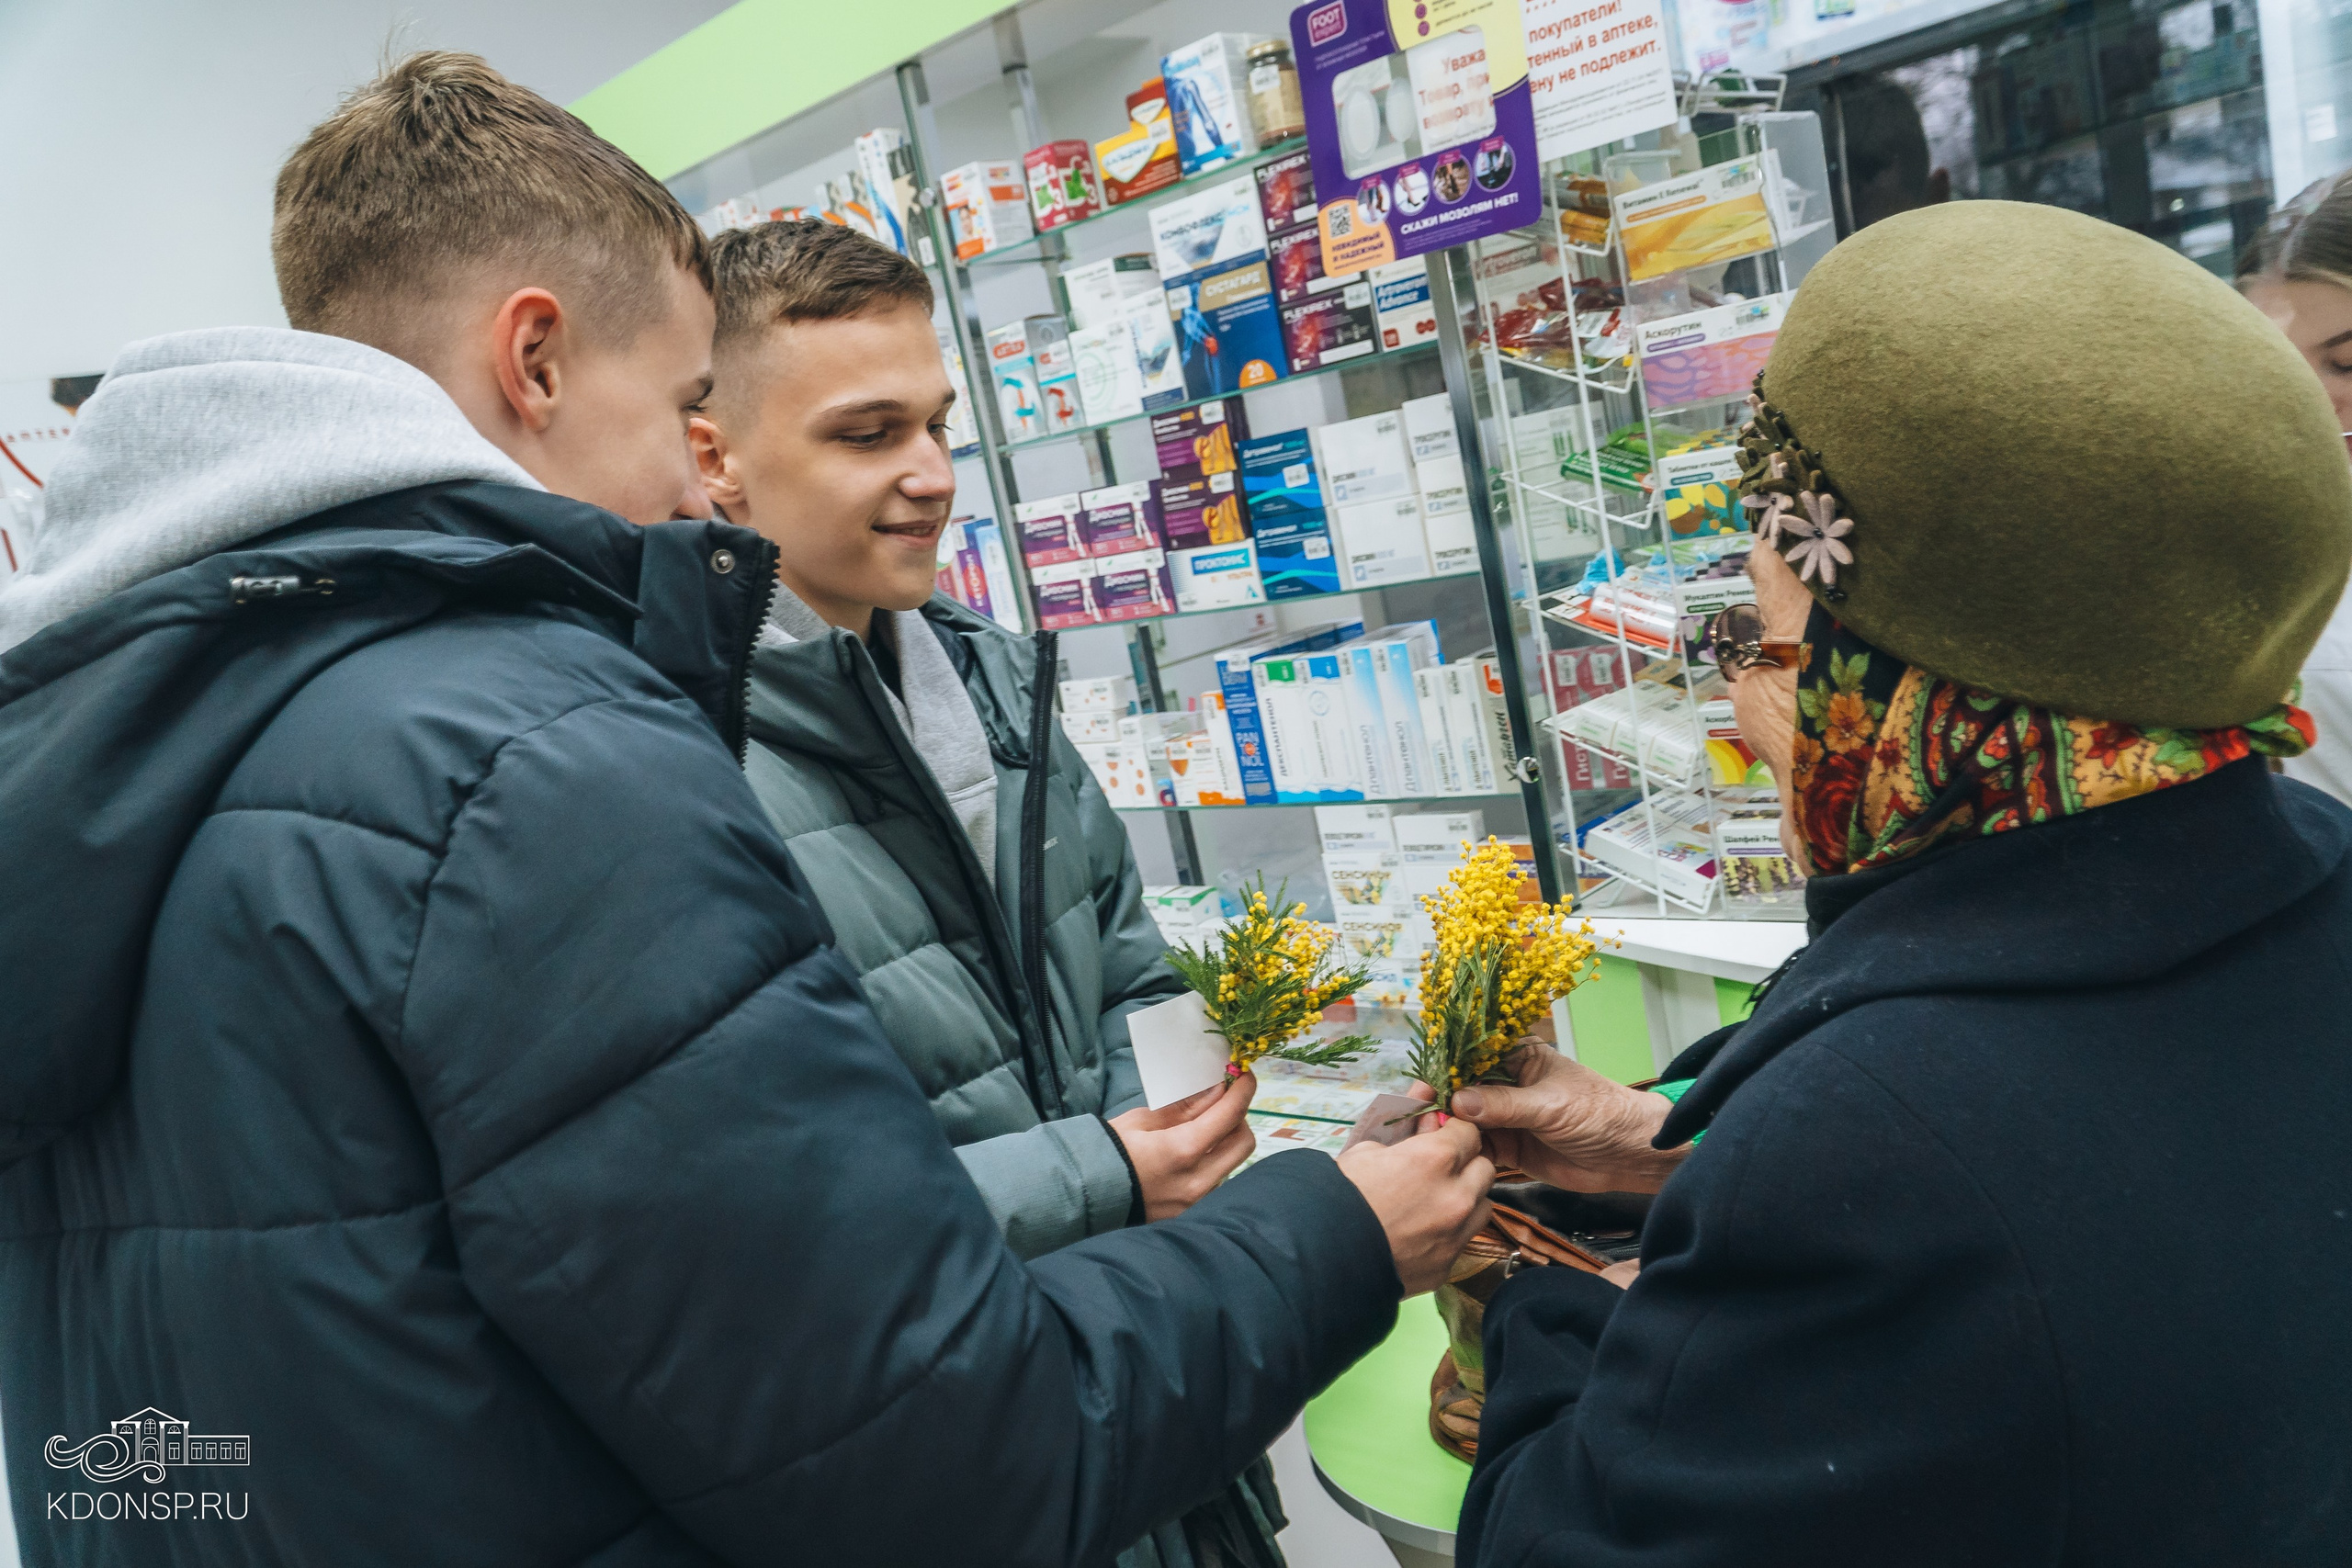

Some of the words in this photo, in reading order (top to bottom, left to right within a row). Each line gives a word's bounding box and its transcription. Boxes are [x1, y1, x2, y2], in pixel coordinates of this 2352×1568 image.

[1311, 7, 1340, 30] FOOT
[1442, 49, 1487, 73] Уважа
[1528, 0, 1623, 44] покупатели!
[1527, 36, 1584, 69] тенный
[1588, 34, 1598, 49] в
[1602, 14, 1658, 44] аптеке,
[1530, 74, 1555, 94] ену
[1558, 67, 1577, 84] не
[1580, 40, 1662, 77] подлежит.
[1623, 194, 1658, 210] Витамин
[1400, 214, 1439, 235] СКАЖИ
[1439, 200, 1494, 224] МОЗОЛЯМ
[1494, 192, 1519, 209] НЕТ!
[1645, 321, 1702, 340] Аскорутин
[1724, 835, 1760, 844] Шалфей
[1761, 834, 1780, 843] Рен
[1332, 871, 1392, 880] СЕНСИНОР
[1342, 921, 1404, 931] СЕНСИНОР
